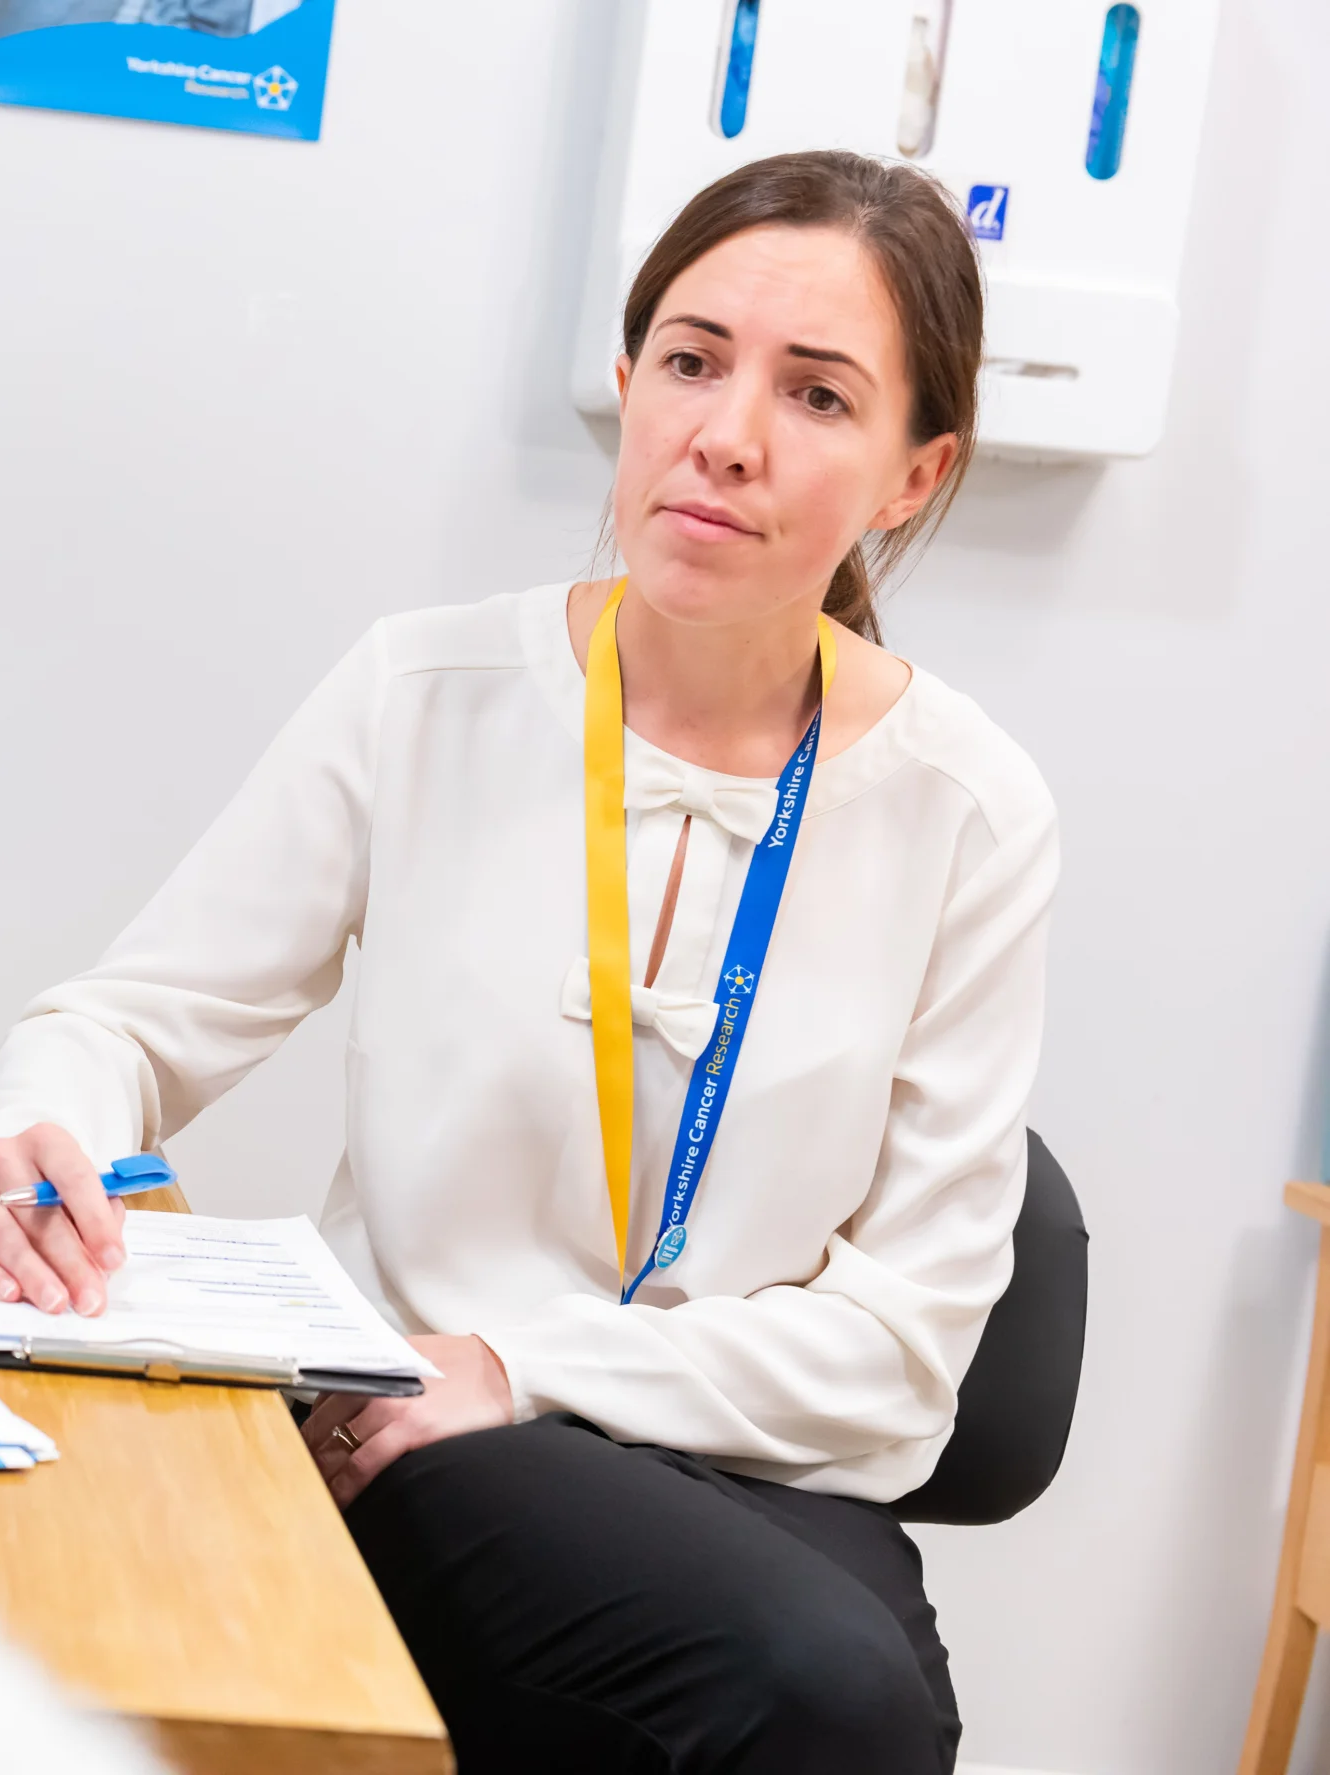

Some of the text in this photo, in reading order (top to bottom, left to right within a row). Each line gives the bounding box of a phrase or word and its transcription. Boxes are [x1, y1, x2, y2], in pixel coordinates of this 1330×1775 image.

[767, 707, 821, 849] Yorkshire Cance
[688, 1077, 718, 1143] Cancer
[705, 997, 742, 1076] Research
